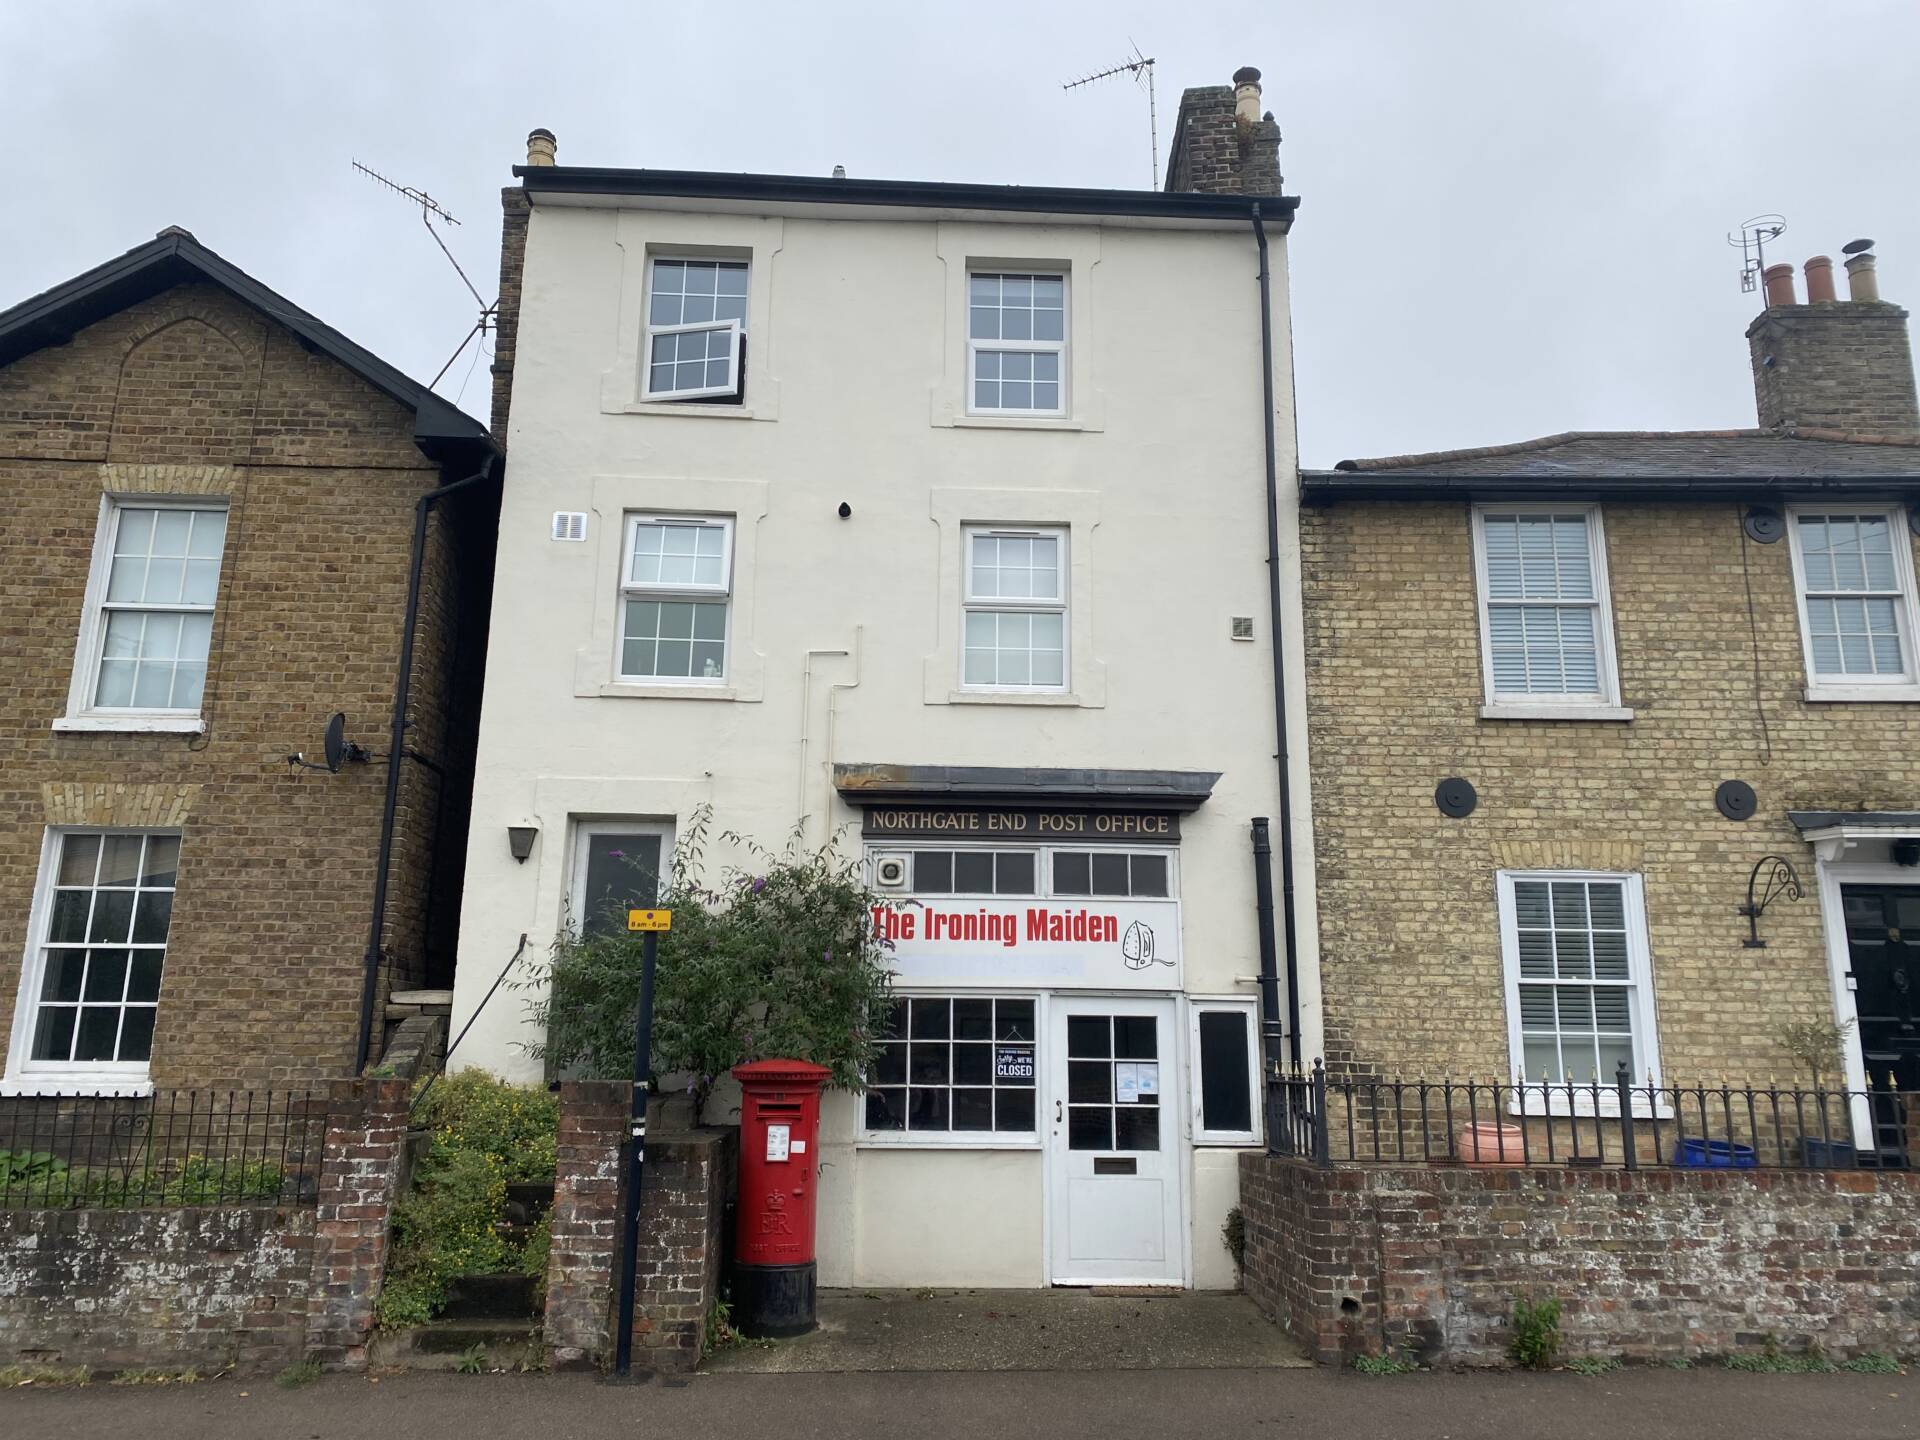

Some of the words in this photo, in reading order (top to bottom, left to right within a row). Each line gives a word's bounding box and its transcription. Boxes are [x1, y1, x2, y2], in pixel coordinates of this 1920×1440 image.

[872, 811, 980, 830] NORTHGATE
[987, 813, 1027, 831] END
[1039, 814, 1088, 832] POST
[1095, 815, 1169, 833] OFFICE
[870, 907, 915, 940] The
[924, 907, 1017, 947] Ironing
[1026, 909, 1118, 942] Maiden
[997, 1064, 1032, 1076] CLOSED
